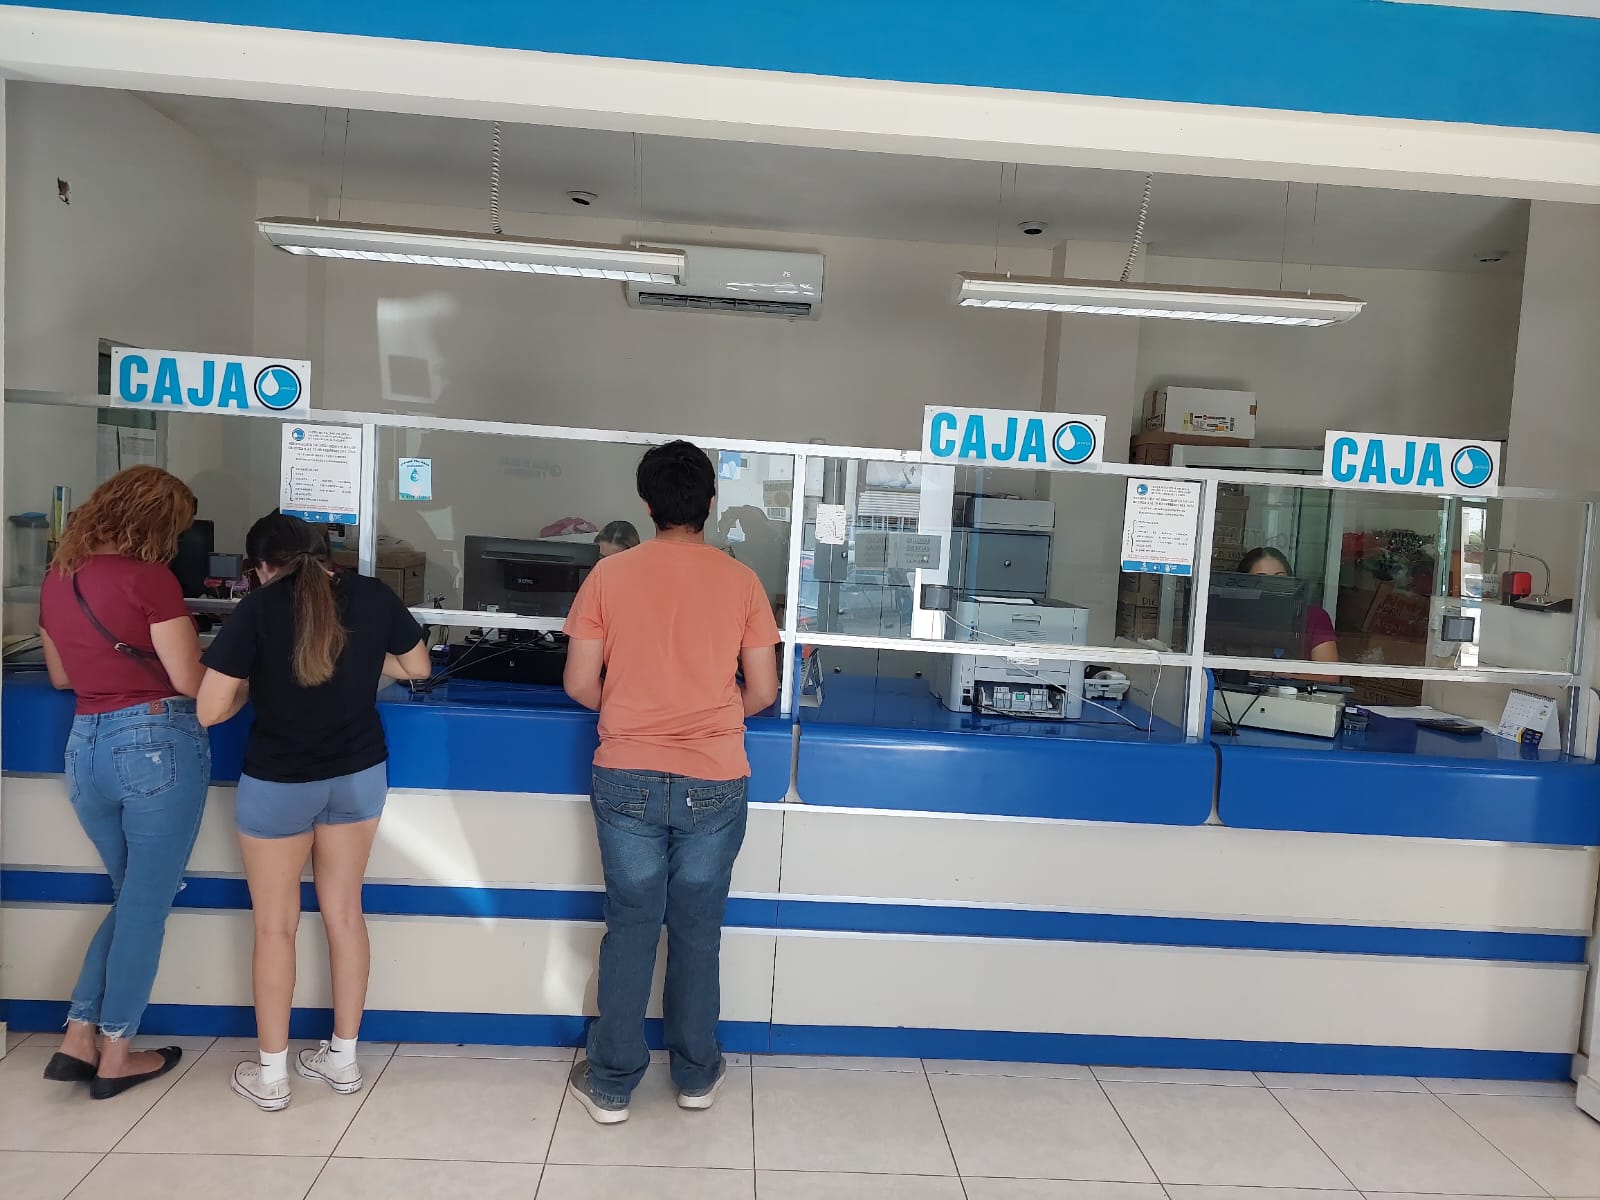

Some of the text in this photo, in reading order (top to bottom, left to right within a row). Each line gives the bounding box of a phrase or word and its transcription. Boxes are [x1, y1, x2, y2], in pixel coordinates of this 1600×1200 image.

[119, 354, 249, 410] CAJA
[930, 411, 1047, 463] CAJA
[1332, 436, 1444, 487] CAJA
